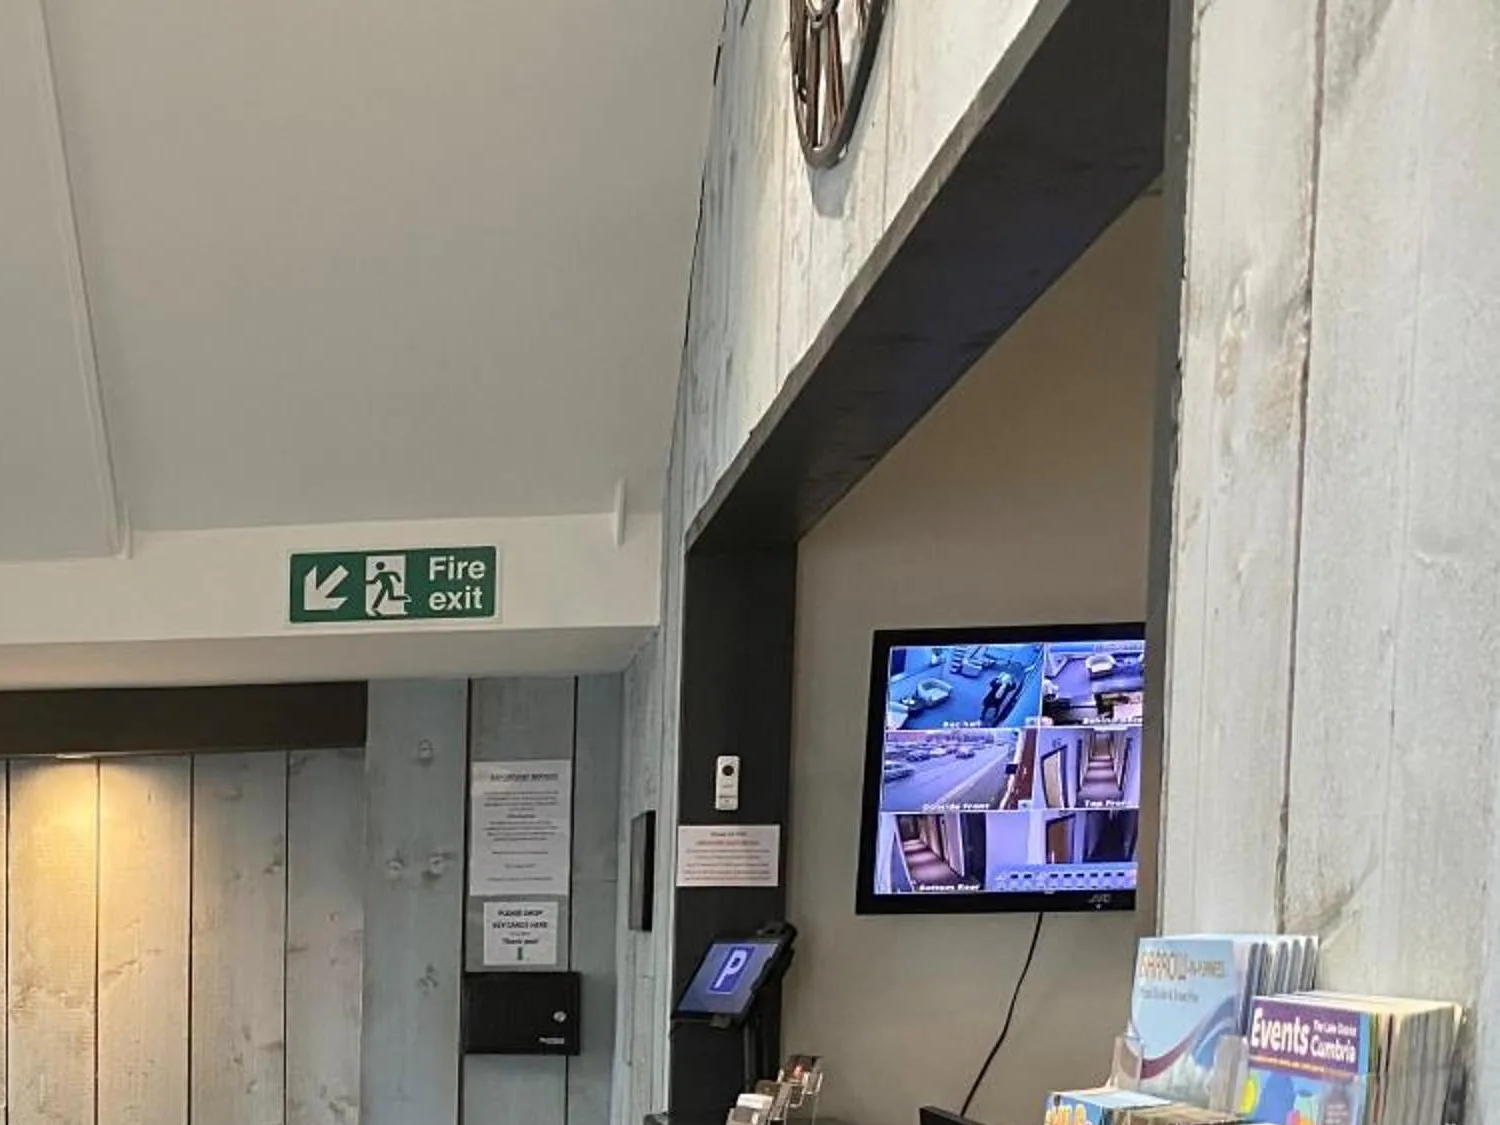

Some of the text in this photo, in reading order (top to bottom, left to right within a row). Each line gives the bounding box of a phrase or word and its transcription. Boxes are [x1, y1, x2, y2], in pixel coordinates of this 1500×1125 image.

[428, 556, 485, 581] Fire
[428, 585, 483, 611] exit
[713, 949, 749, 990] P
[1251, 1007, 1311, 1056] Events
[1309, 1034, 1356, 1063] Cumbria
